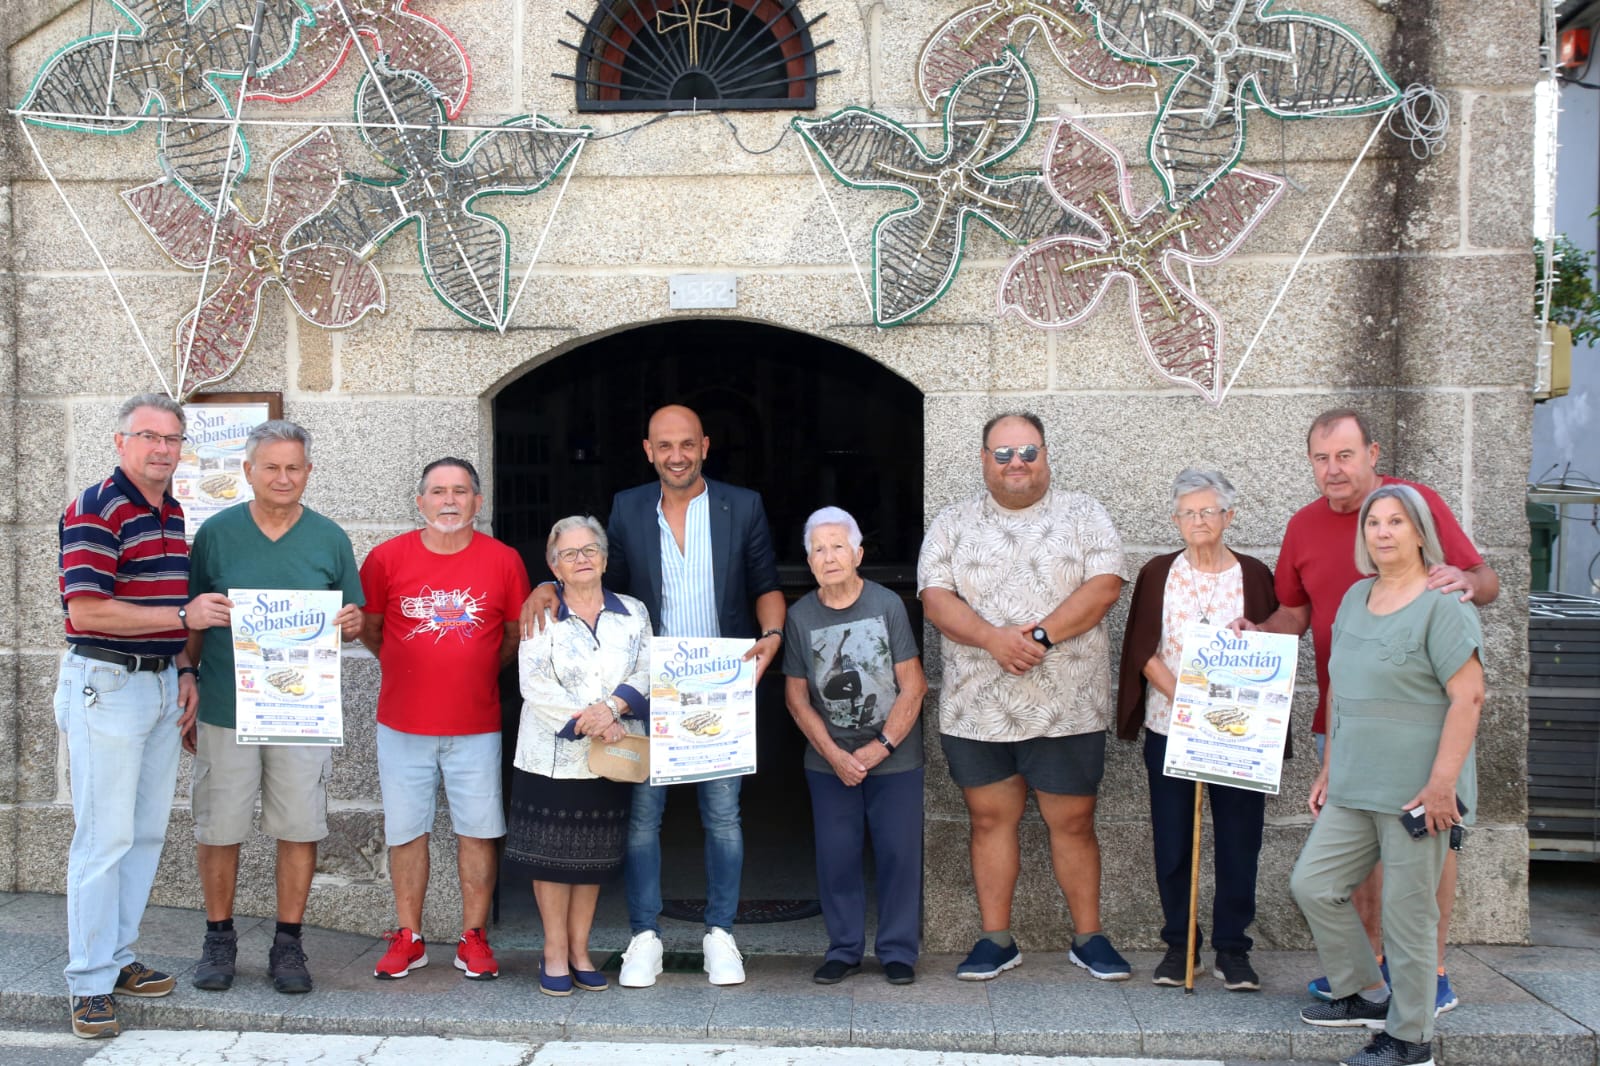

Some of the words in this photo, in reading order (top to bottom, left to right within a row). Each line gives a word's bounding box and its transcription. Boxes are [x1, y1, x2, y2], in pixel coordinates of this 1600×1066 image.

[193, 409, 225, 431] San
[252, 593, 290, 616] San
[239, 608, 326, 639] Sebastián
[673, 641, 709, 663] San
[1209, 630, 1249, 651] San
[659, 656, 742, 683] Sebastián
[1191, 648, 1282, 678] Sebastián
